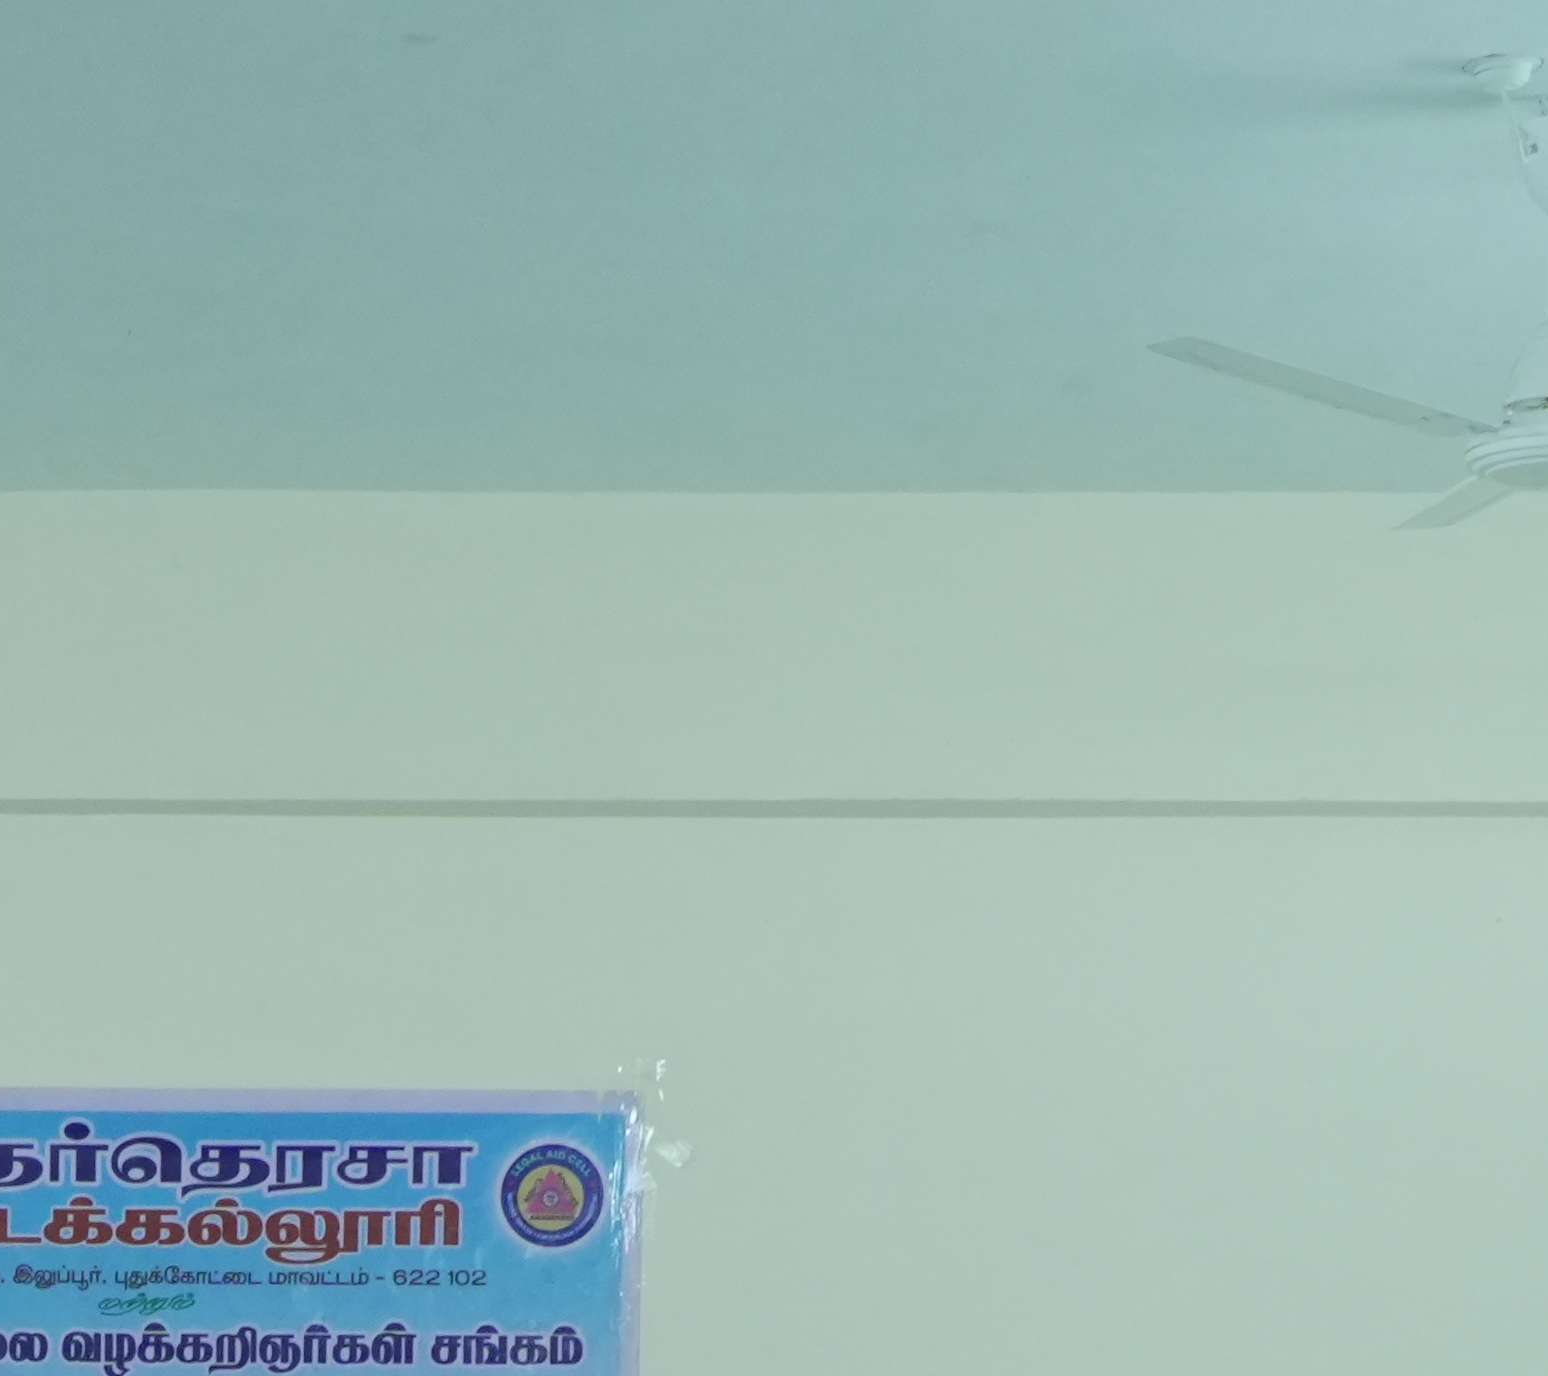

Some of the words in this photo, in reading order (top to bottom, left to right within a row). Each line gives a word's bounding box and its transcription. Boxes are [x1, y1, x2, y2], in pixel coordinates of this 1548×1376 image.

[510, 1151, 544, 1177] LEGAL
[546, 1148, 566, 1159] AID
[568, 1154, 592, 1177] CELL
[114, 1265, 262, 1290] புதுக்கோட்டை
[268, 1267, 370, 1286] மாவட்டம்
[392, 1268, 441, 1287] 622
[448, 1269, 488, 1287] 102
[430, 1324, 584, 1366] சங்கம்
